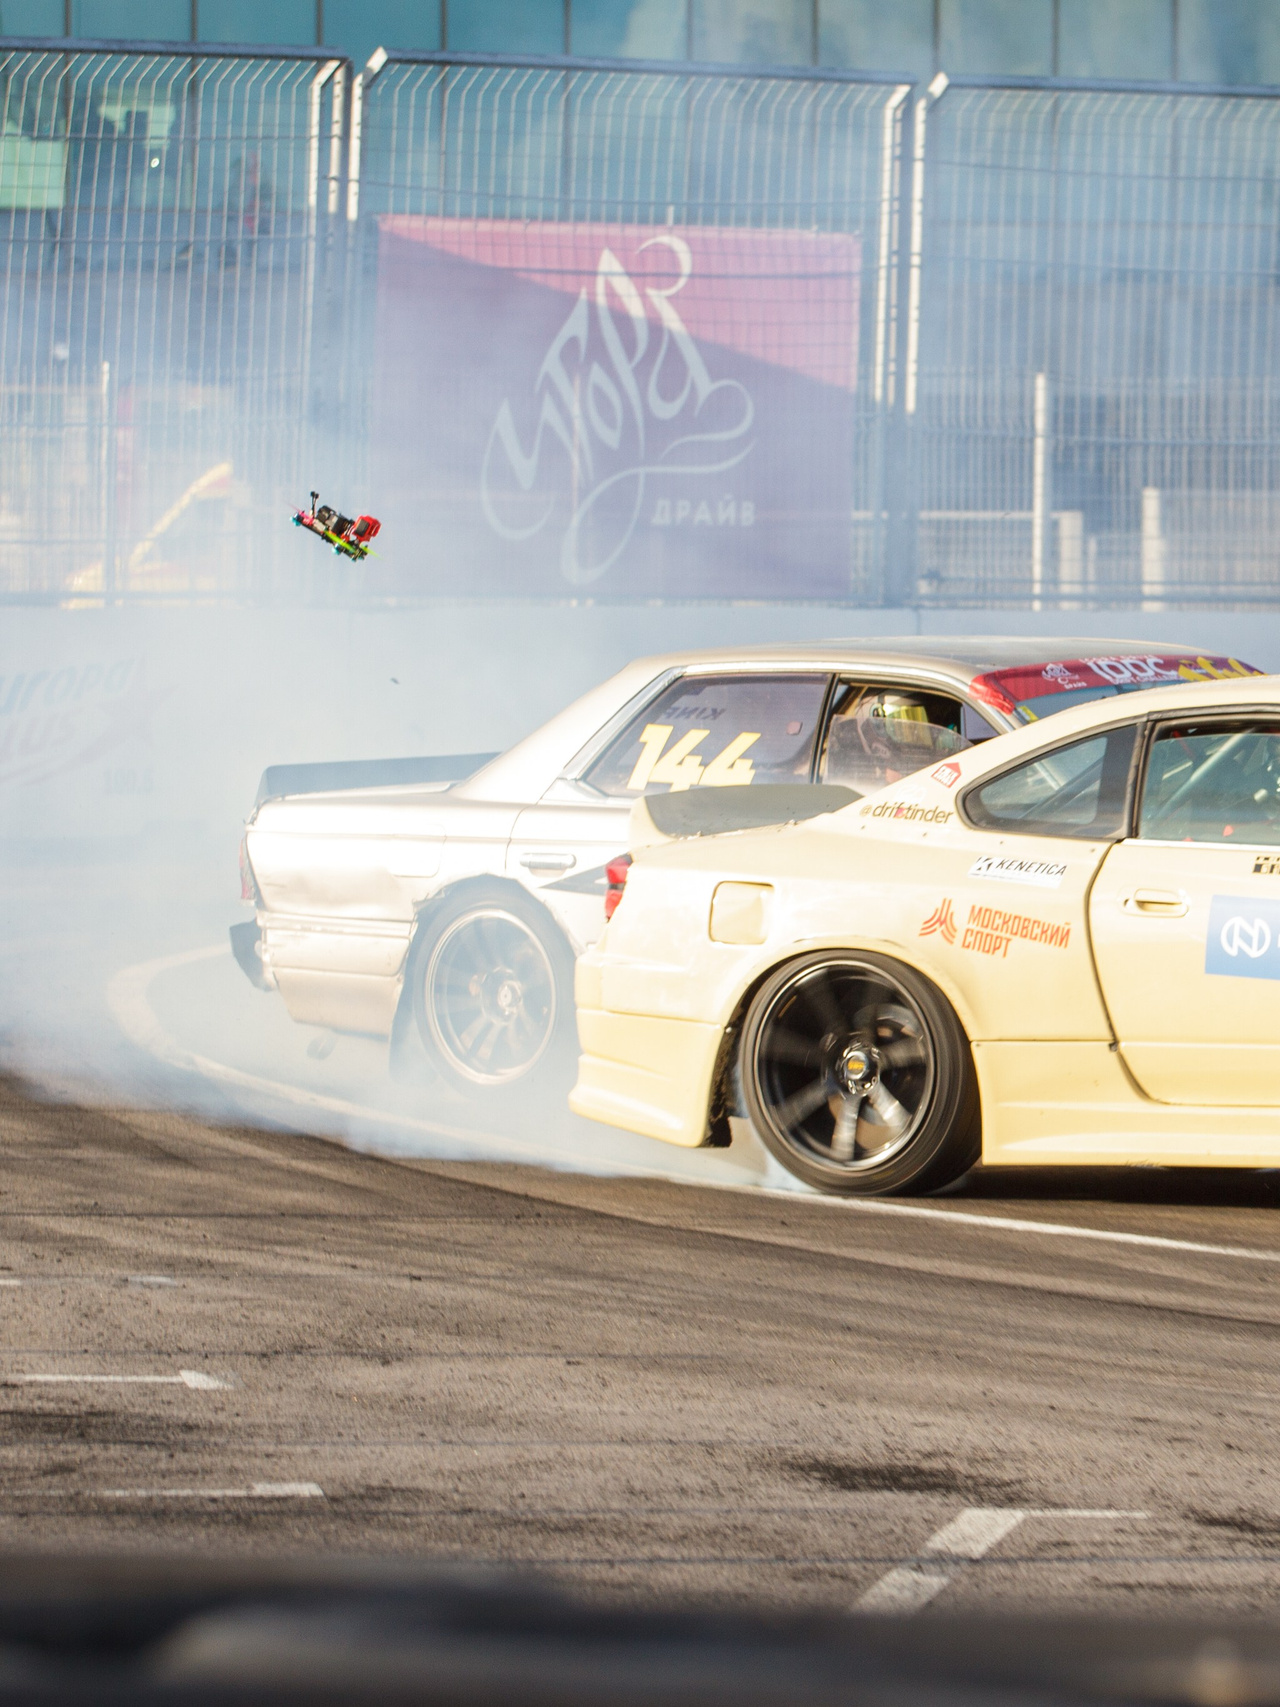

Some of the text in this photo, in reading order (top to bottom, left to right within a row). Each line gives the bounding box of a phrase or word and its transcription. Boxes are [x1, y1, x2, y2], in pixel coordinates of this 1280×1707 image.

[651, 496, 756, 527] ДРАЙВ
[626, 724, 761, 793] 144
[995, 858, 1068, 876] KENETICA
[967, 903, 1072, 949] МОСКОВСКИЙ
[961, 929, 1012, 959] СПОРТ
